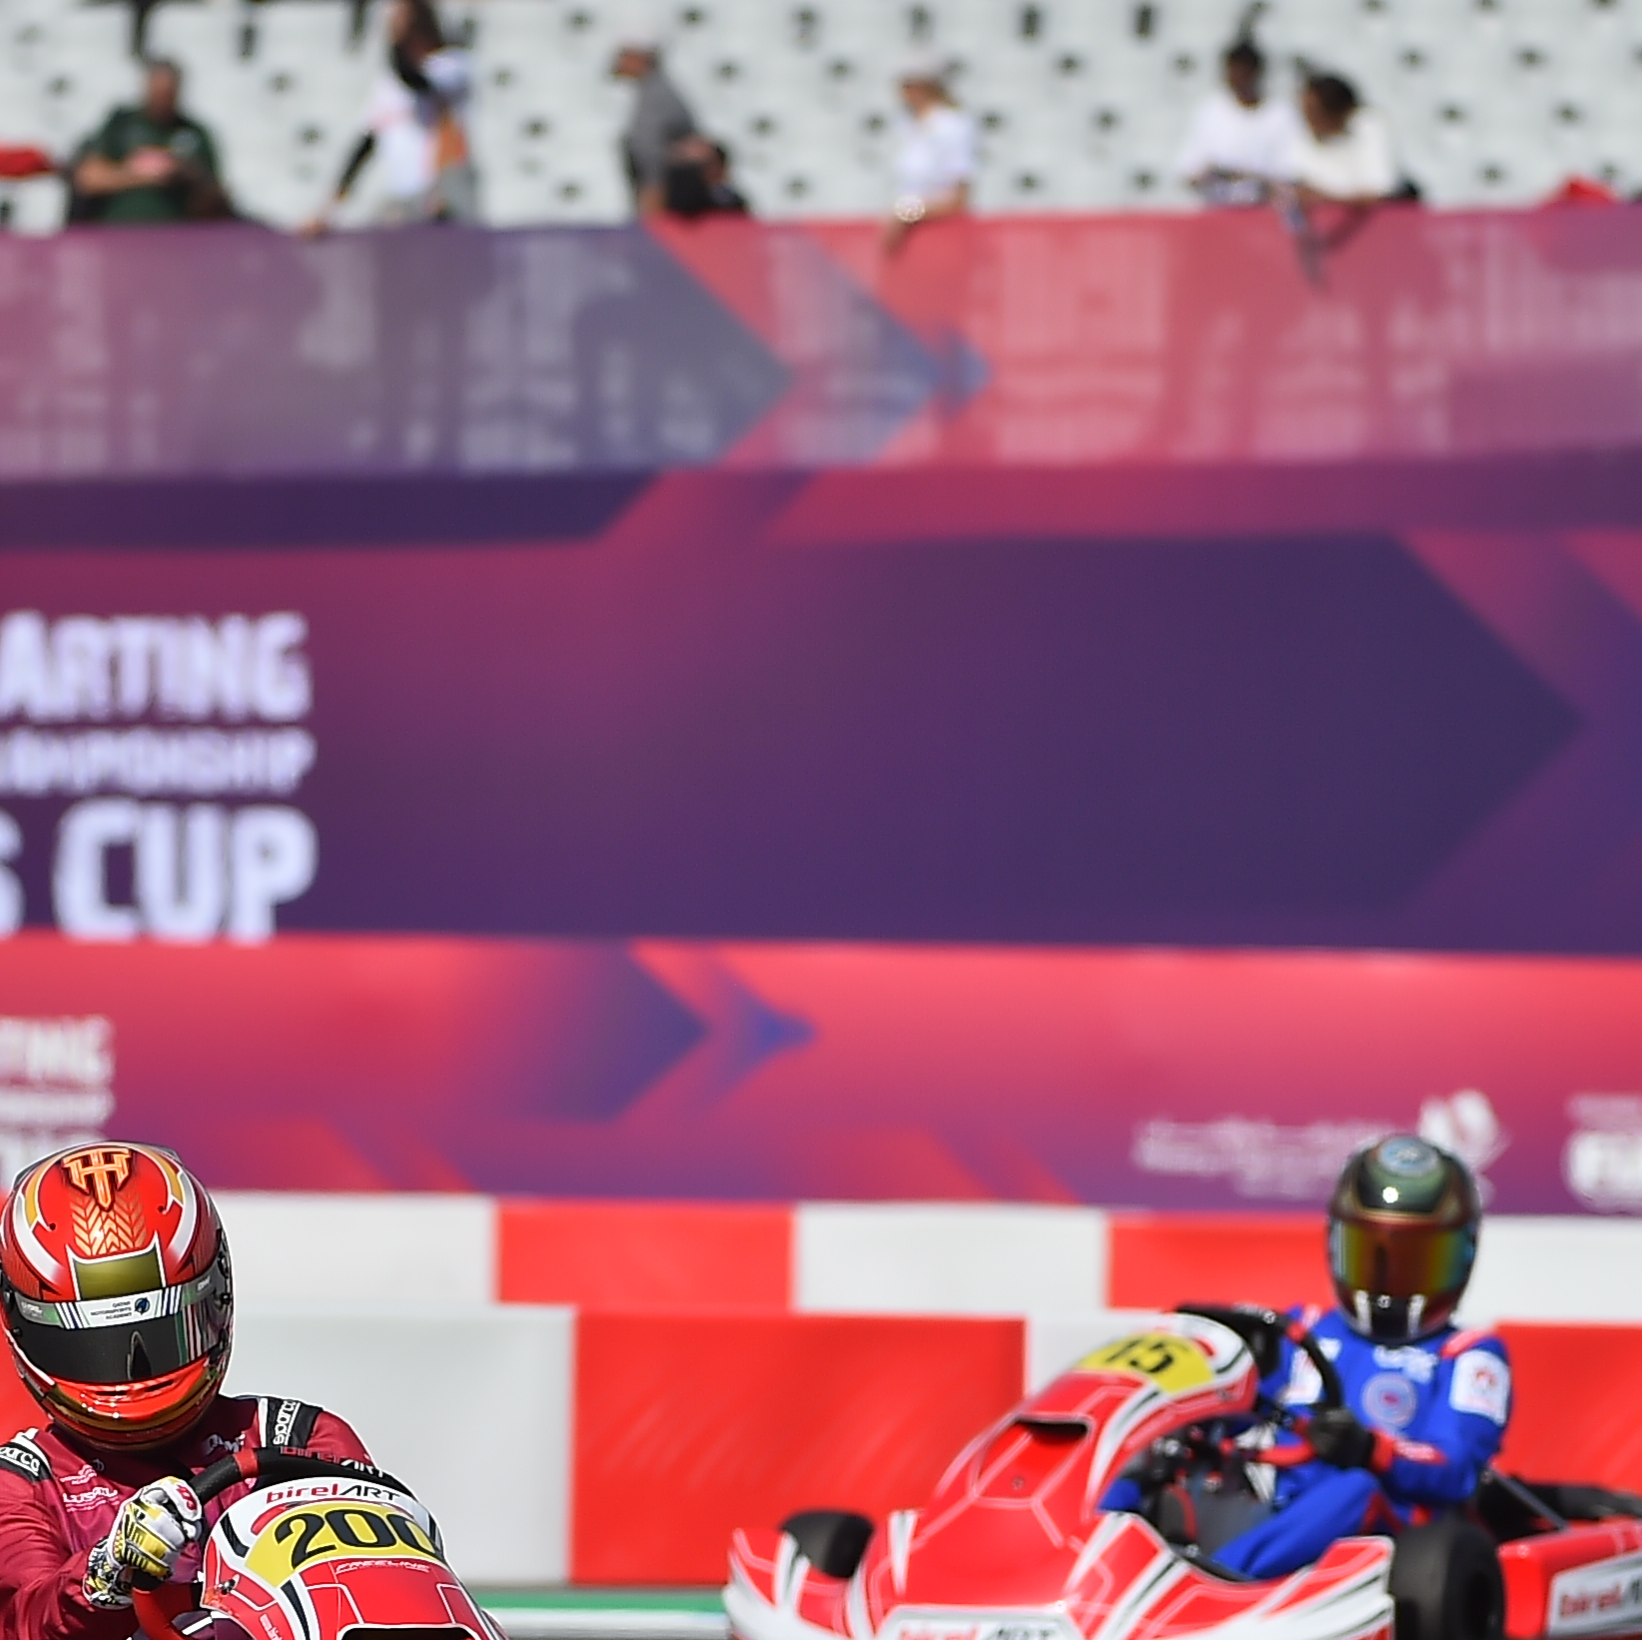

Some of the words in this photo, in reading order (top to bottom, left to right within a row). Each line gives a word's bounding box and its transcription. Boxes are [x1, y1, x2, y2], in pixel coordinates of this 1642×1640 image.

[53, 799, 318, 943] CUP
[267, 1483, 401, 1504] birelART
[273, 1508, 445, 1570] 200
